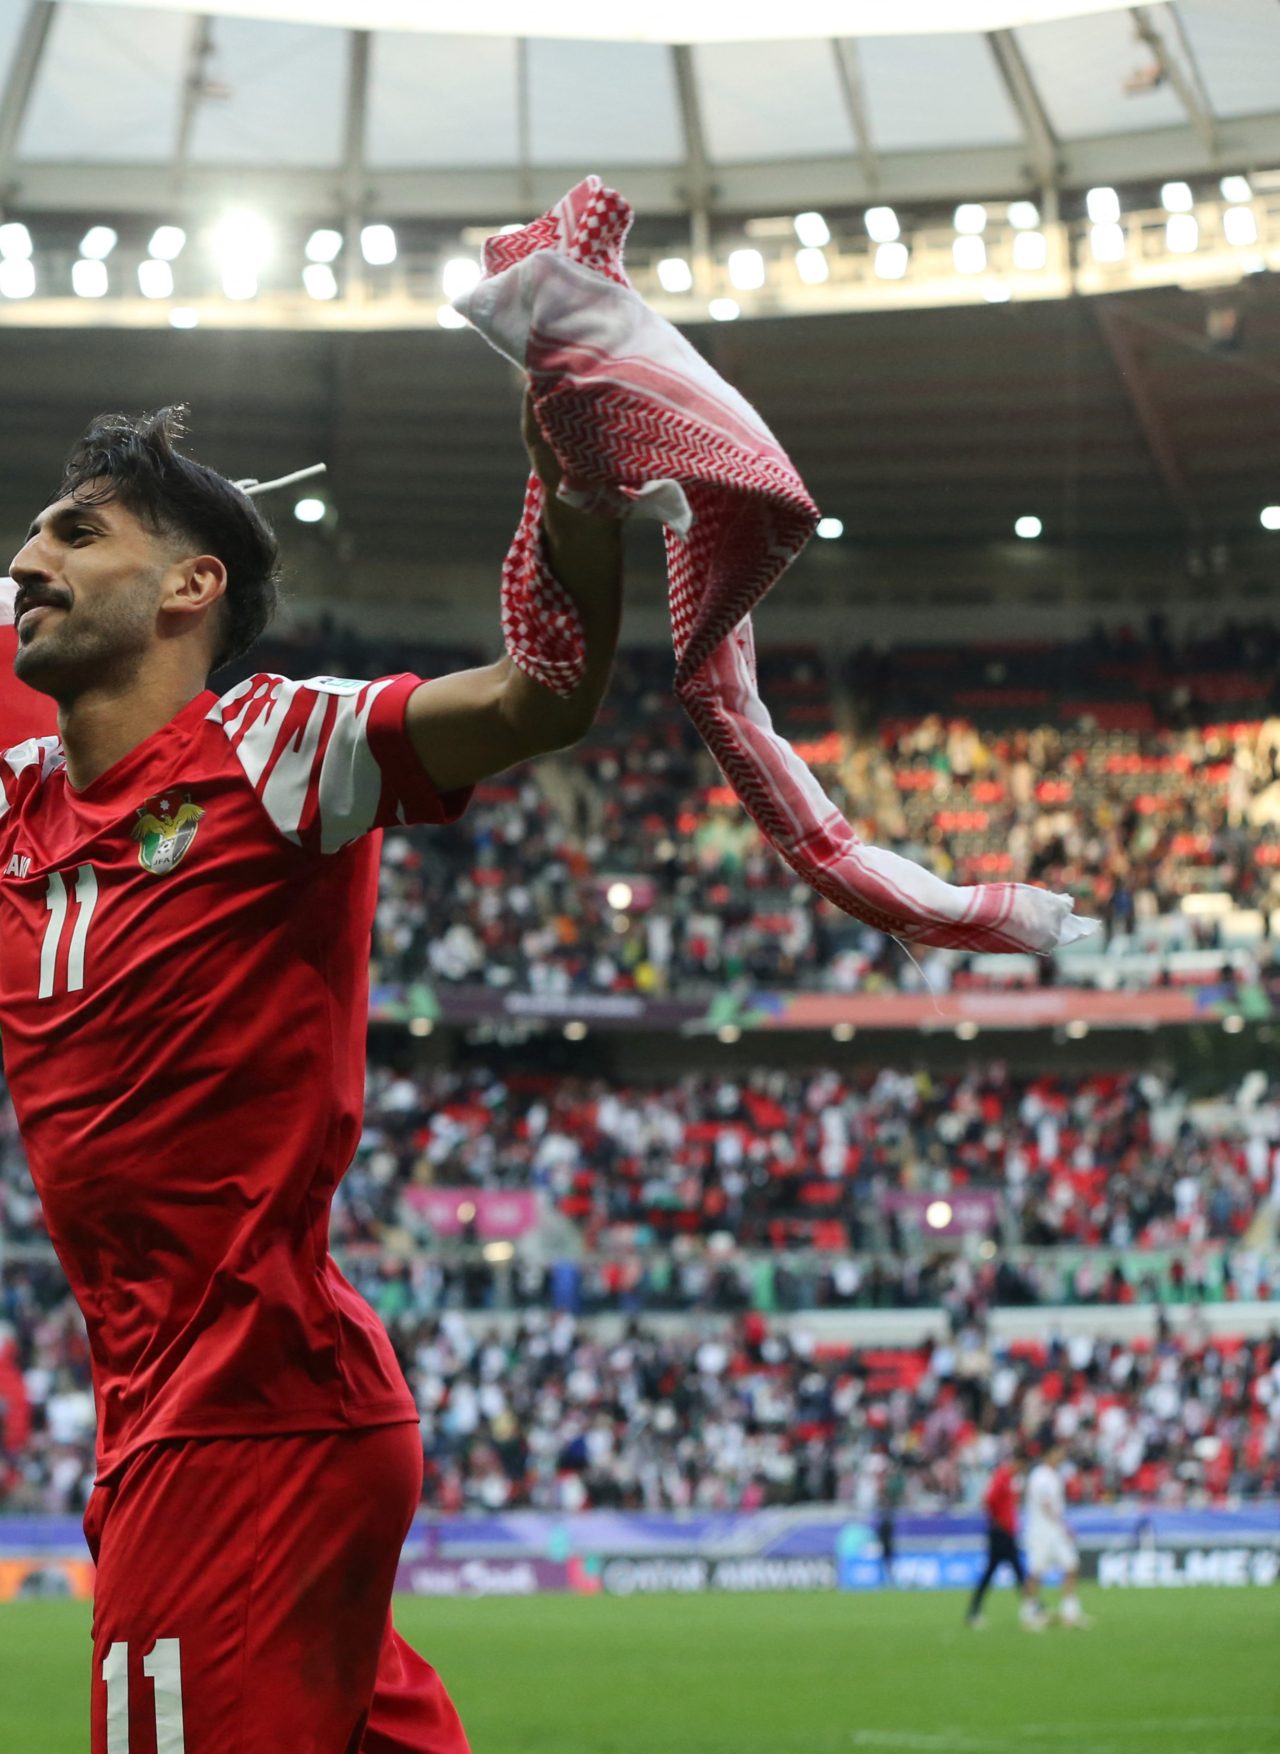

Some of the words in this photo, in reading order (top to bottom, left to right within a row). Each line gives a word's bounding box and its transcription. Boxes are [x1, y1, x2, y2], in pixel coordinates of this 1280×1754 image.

[153, 857, 171, 866] JFA
[38, 864, 99, 1000] 11
[102, 1637, 185, 1754] 11
